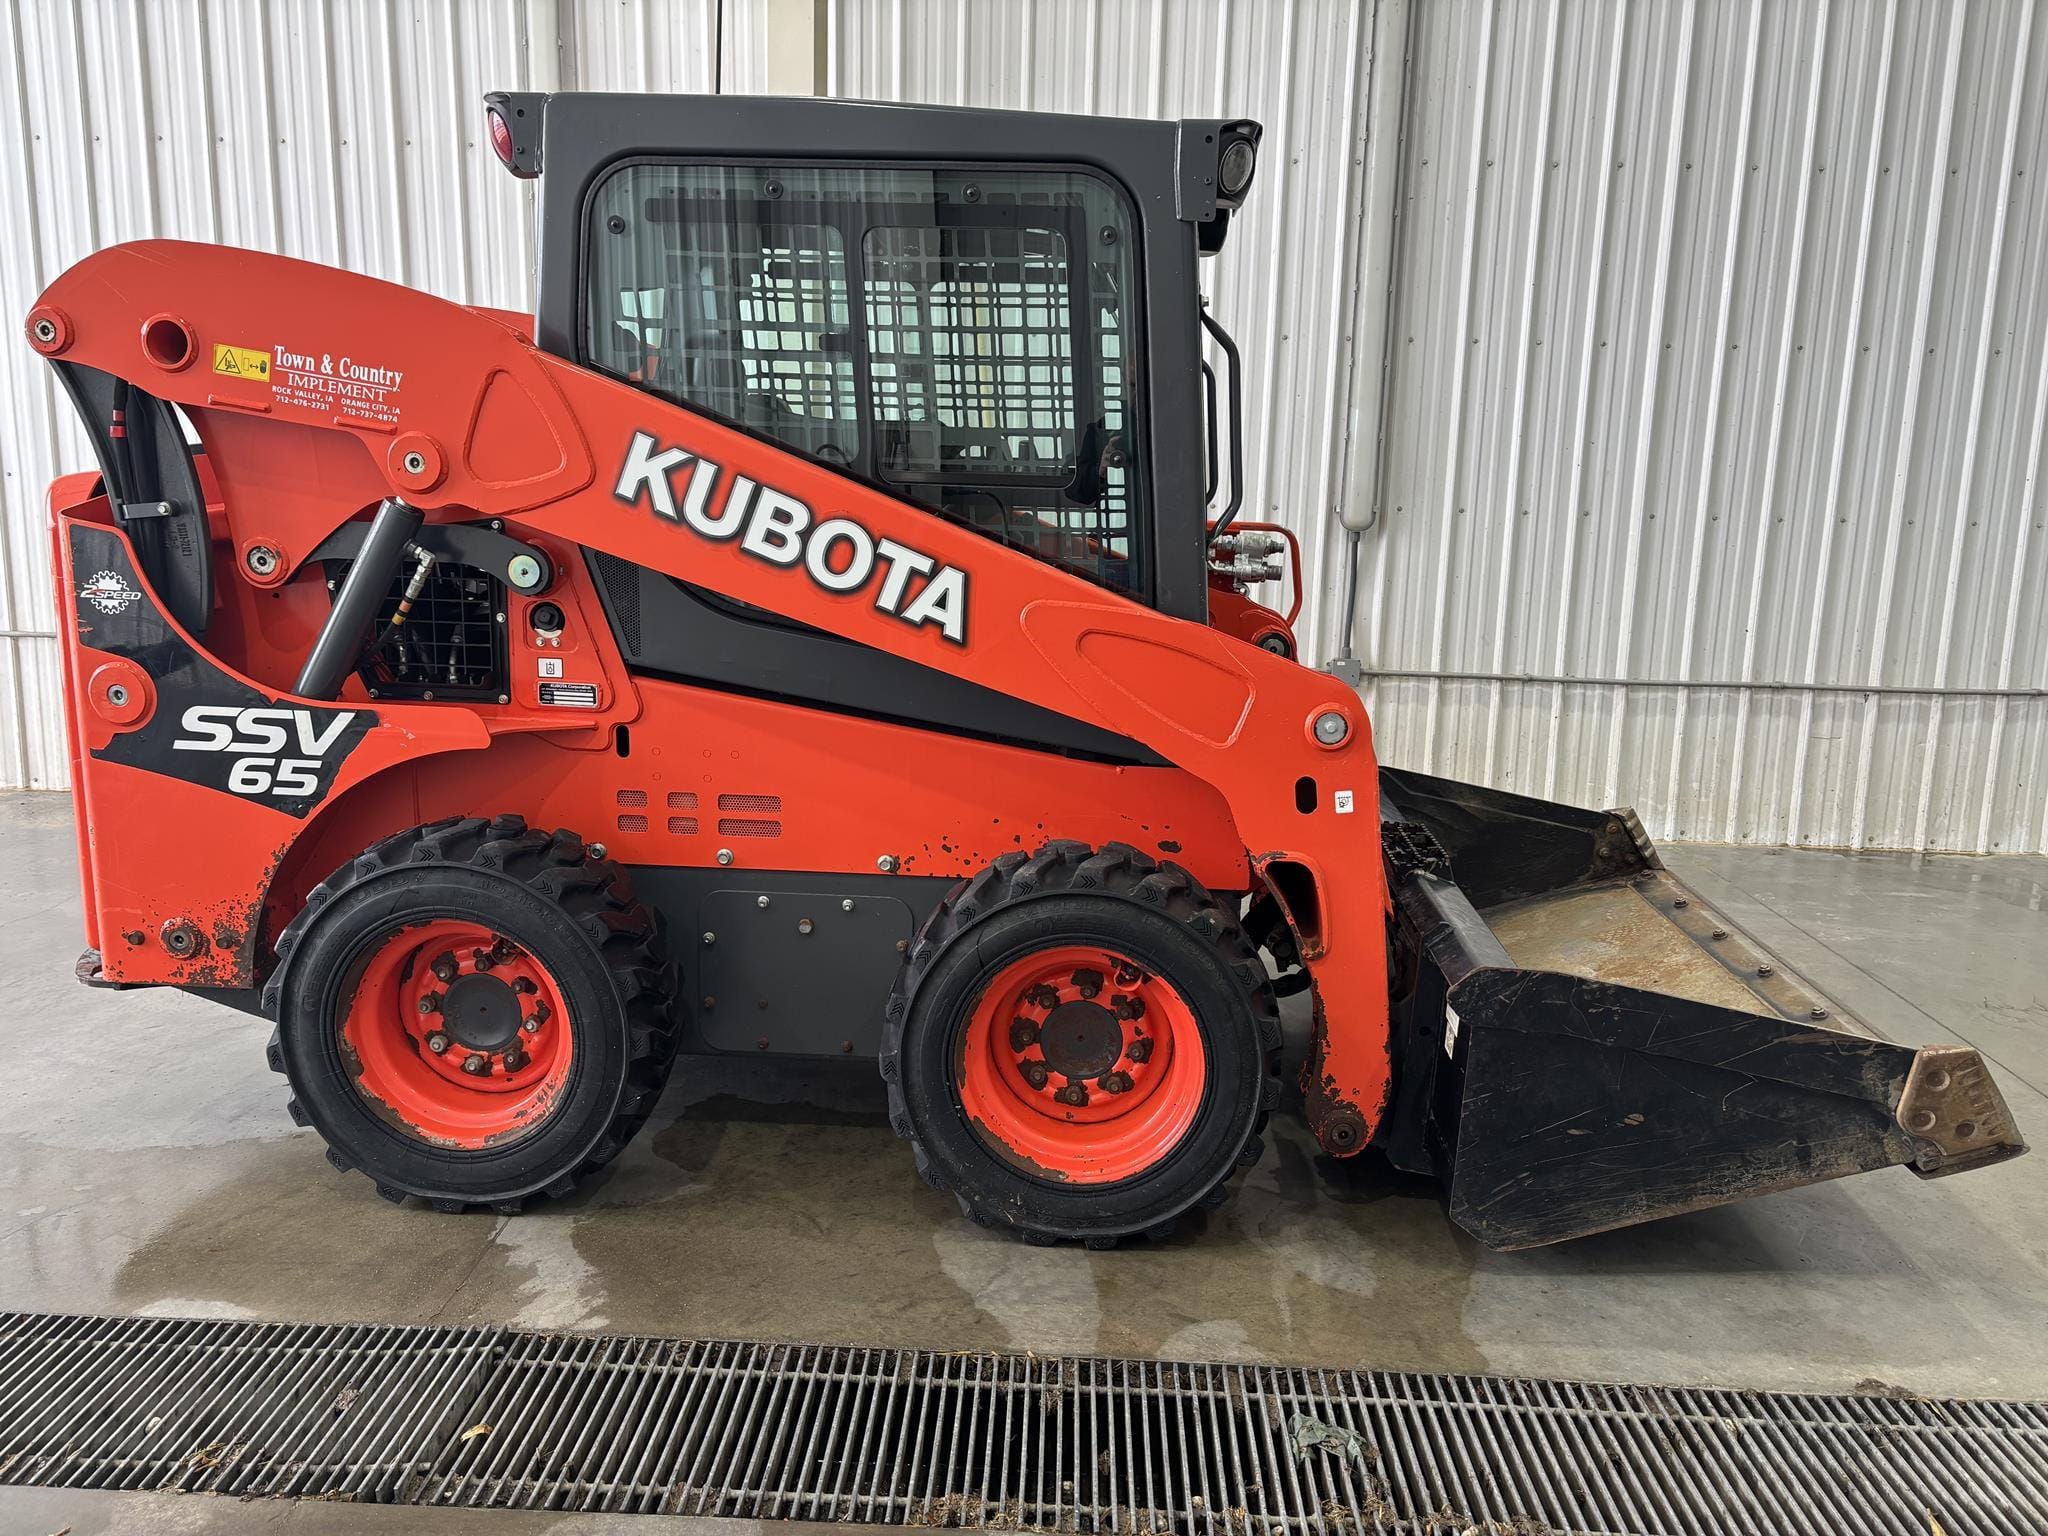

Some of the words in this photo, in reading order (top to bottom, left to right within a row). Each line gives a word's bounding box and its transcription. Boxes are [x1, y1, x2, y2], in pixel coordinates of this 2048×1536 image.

[275, 345, 315, 372] Town
[321, 354, 333, 374] &
[339, 357, 403, 392] Country
[272, 385, 291, 395] ROCK
[295, 389, 324, 402] VALLEY,
[325, 395, 334, 403] IA
[288, 373, 387, 402] IMPLEMENT
[276, 395, 329, 411] 712-476-2731
[341, 398, 371, 410] ORANGE
[392, 406, 401, 415] IA
[343, 406, 398, 423] 712-737-4874
[614, 431, 966, 644] KUBOTA
[173, 705, 356, 756] SSV
[228, 757, 323, 796] 65
